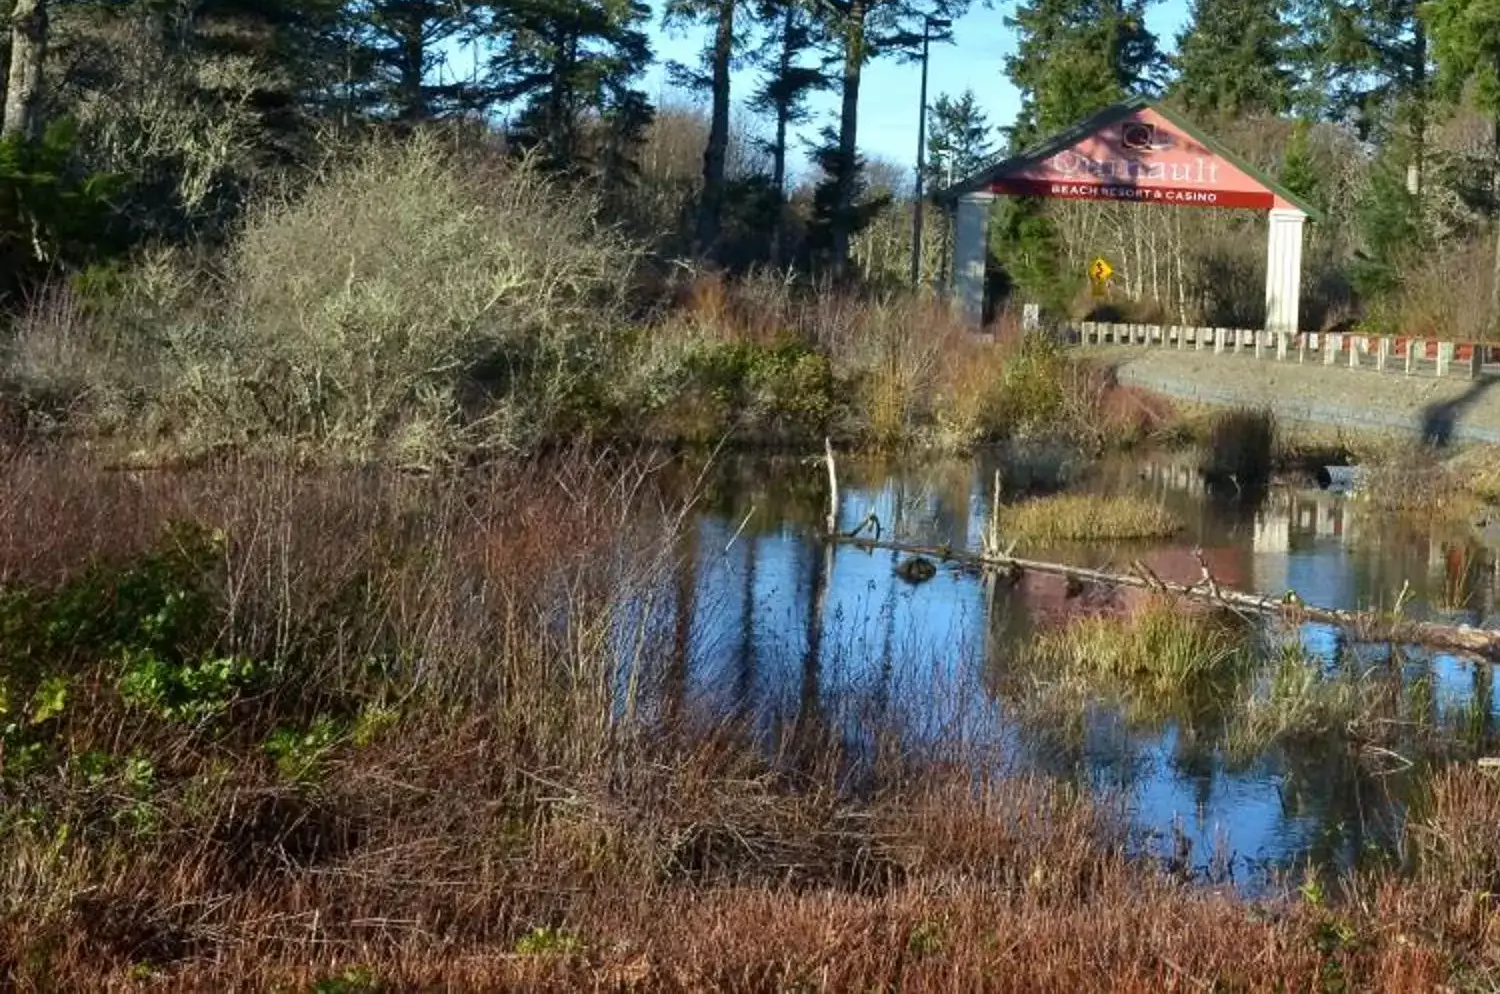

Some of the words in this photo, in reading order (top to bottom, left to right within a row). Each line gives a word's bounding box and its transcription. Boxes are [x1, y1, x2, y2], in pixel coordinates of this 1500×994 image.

[1051, 184, 1098, 196] BEACH
[1100, 186, 1151, 199] RESORT
[1153, 188, 1163, 199] &
[1165, 190, 1217, 202] CASINO
